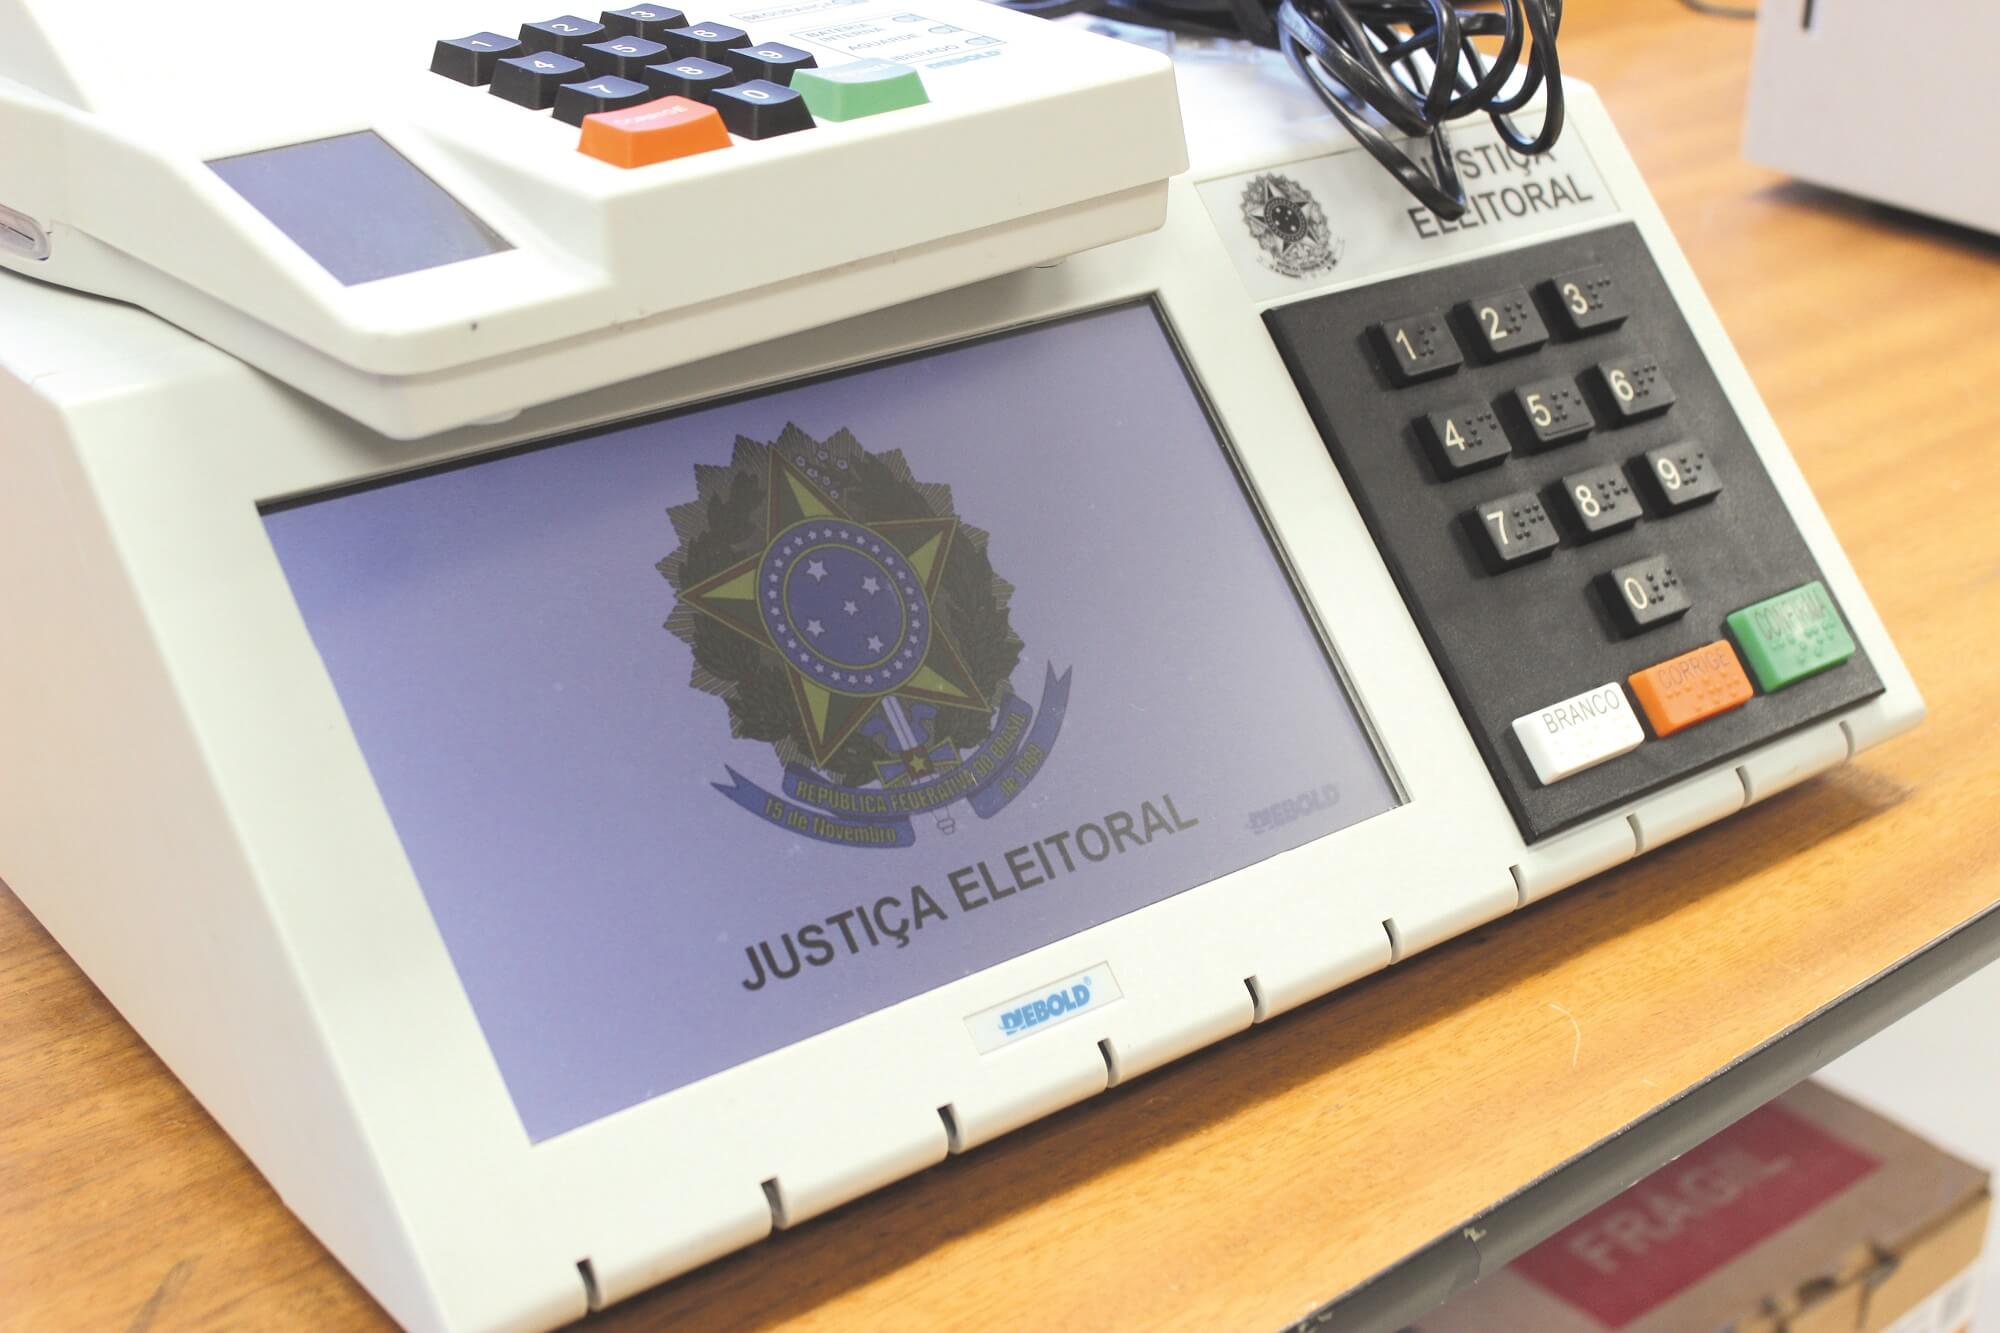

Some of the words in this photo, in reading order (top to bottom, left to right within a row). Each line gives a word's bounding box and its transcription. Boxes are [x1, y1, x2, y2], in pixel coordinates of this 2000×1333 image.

[471, 40, 493, 48] 1
[551, 23, 579, 33] 2
[630, 10, 656, 18] 3
[533, 60, 556, 69] 4
[611, 44, 637, 53] 5
[589, 84, 613, 94] 7
[677, 66, 704, 75] 8
[758, 50, 783, 59] 9
[889, 45, 960, 61] IBERADO
[742, 89, 770, 99] 0
[1396, 329, 1416, 360] 1
[1480, 307, 1507, 340] 2
[1563, 283, 1588, 315] 3
[1445, 419, 1466, 451] 4
[1526, 394, 1551, 427] 5
[1609, 369, 1634, 401] 6
[1487, 510, 1509, 545] 7
[1575, 485, 1600, 518] 8
[1657, 458, 1681, 490] 9
[1624, 577, 1648, 609] 0
[1657, 646, 1731, 691] CORRIGE
[1542, 689, 1620, 735] BRANCO
[764, 799, 784, 820] 15
[788, 809, 808, 831] de
[813, 815, 898, 843] Novembro
[741, 883, 947, 991] JUSTIÇA
[948, 793, 1199, 913] ELEITORAL
